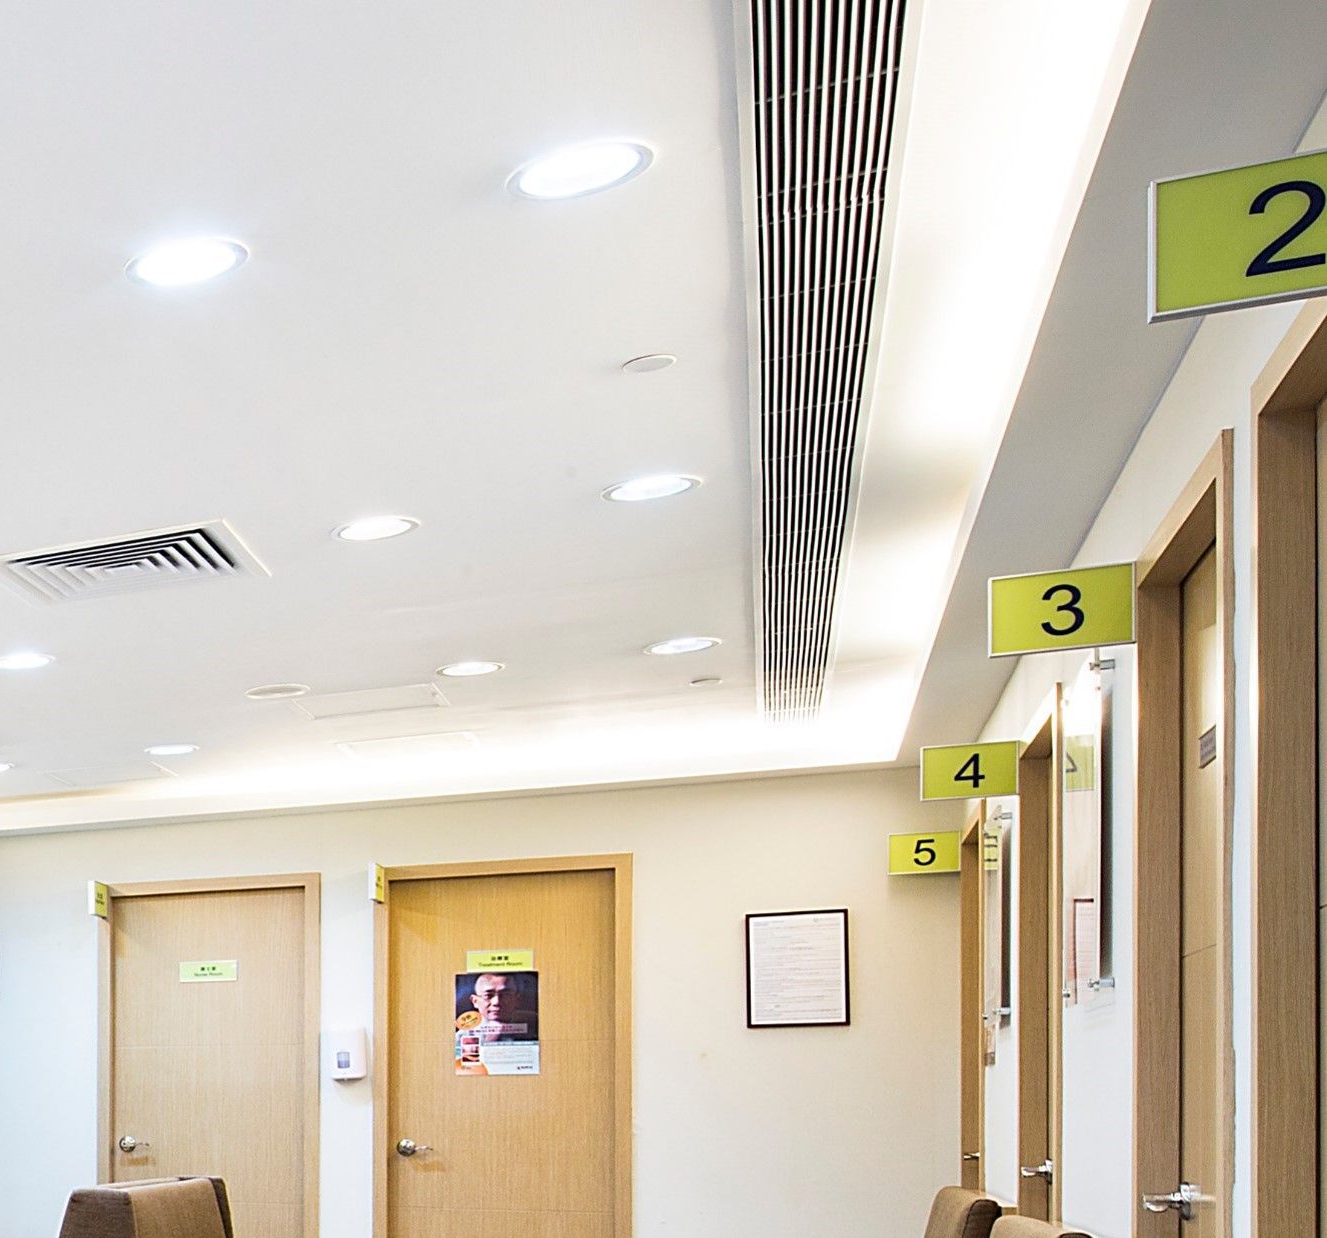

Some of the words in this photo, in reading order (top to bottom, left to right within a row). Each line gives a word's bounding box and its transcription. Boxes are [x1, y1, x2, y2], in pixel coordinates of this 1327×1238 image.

[1245, 180, 1326, 277] 2
[1041, 583, 1085, 636] 3
[953, 753, 985, 788] 4
[912, 838, 936, 867] 5
